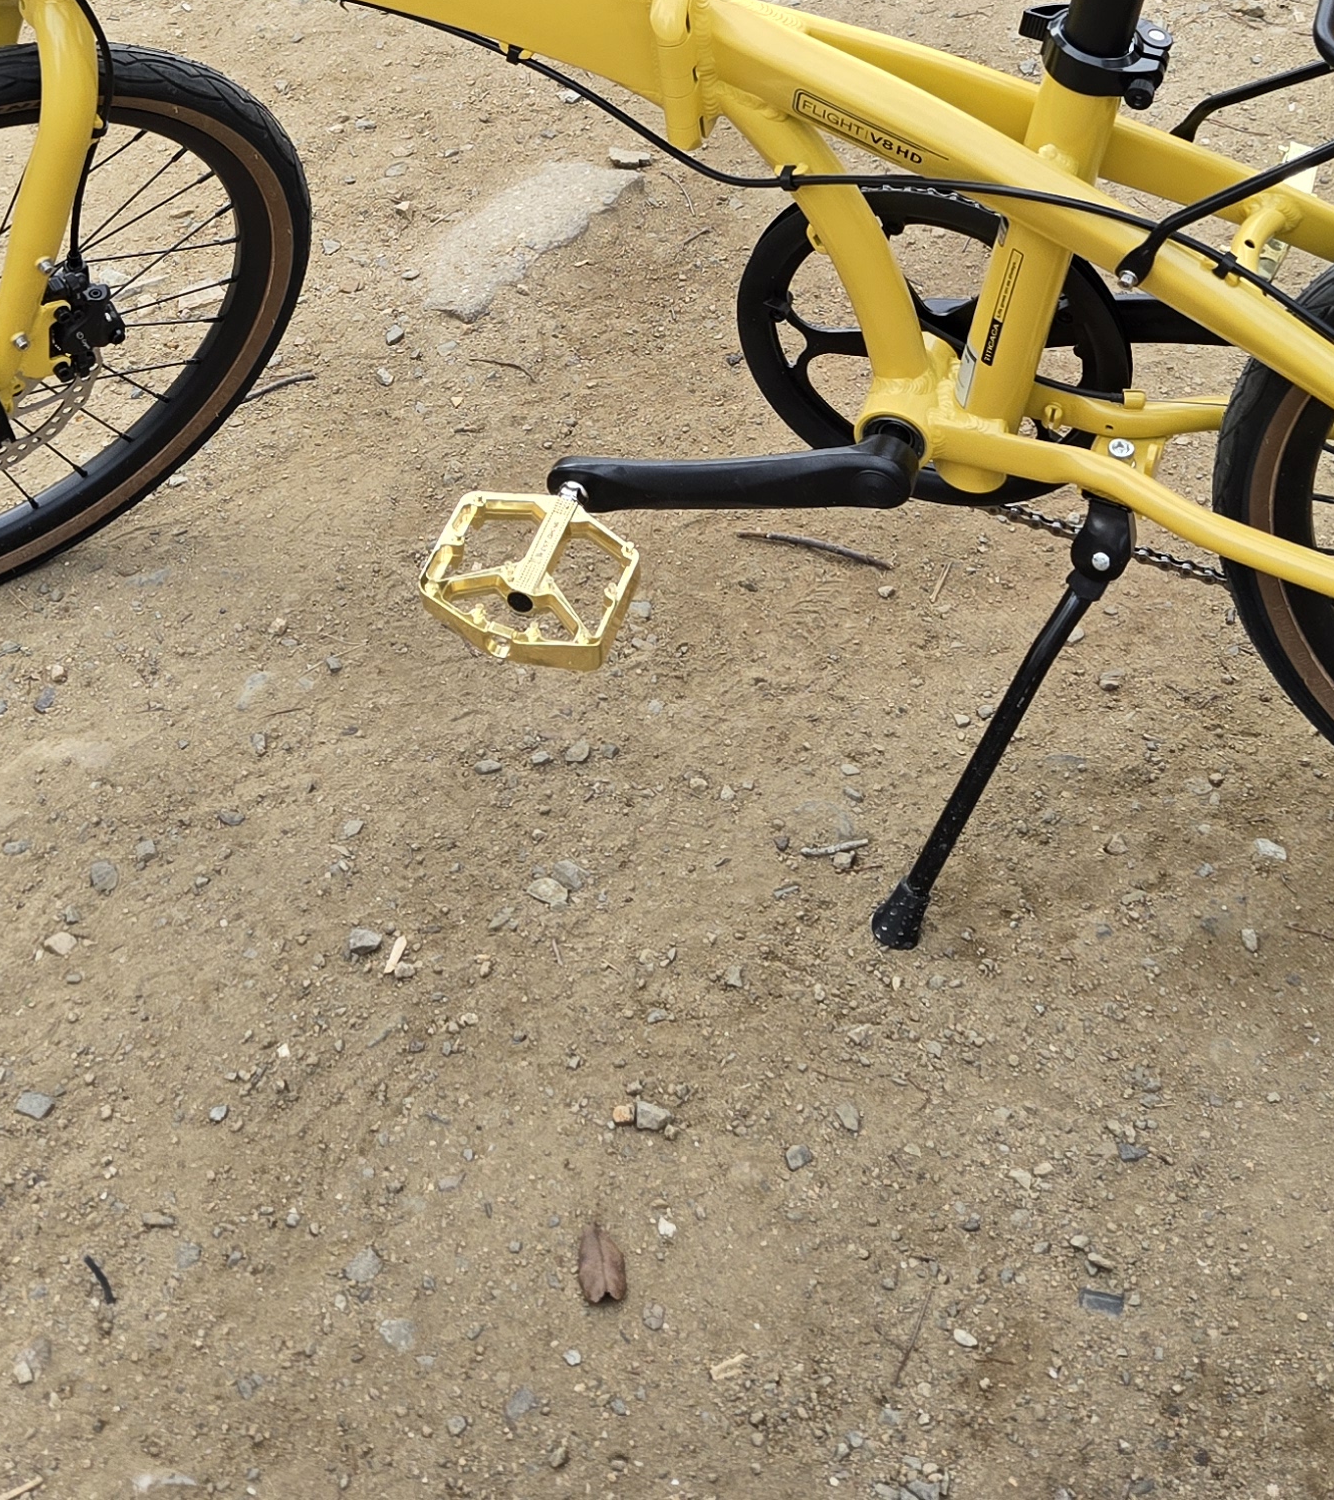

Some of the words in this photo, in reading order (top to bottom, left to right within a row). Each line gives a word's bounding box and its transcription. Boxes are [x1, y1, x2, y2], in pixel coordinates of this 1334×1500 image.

[802, 99, 864, 136] FLIGHT
[870, 131, 894, 151] V8
[895, 145, 923, 164] HD
[983, 323, 1000, 362] TITICACA
